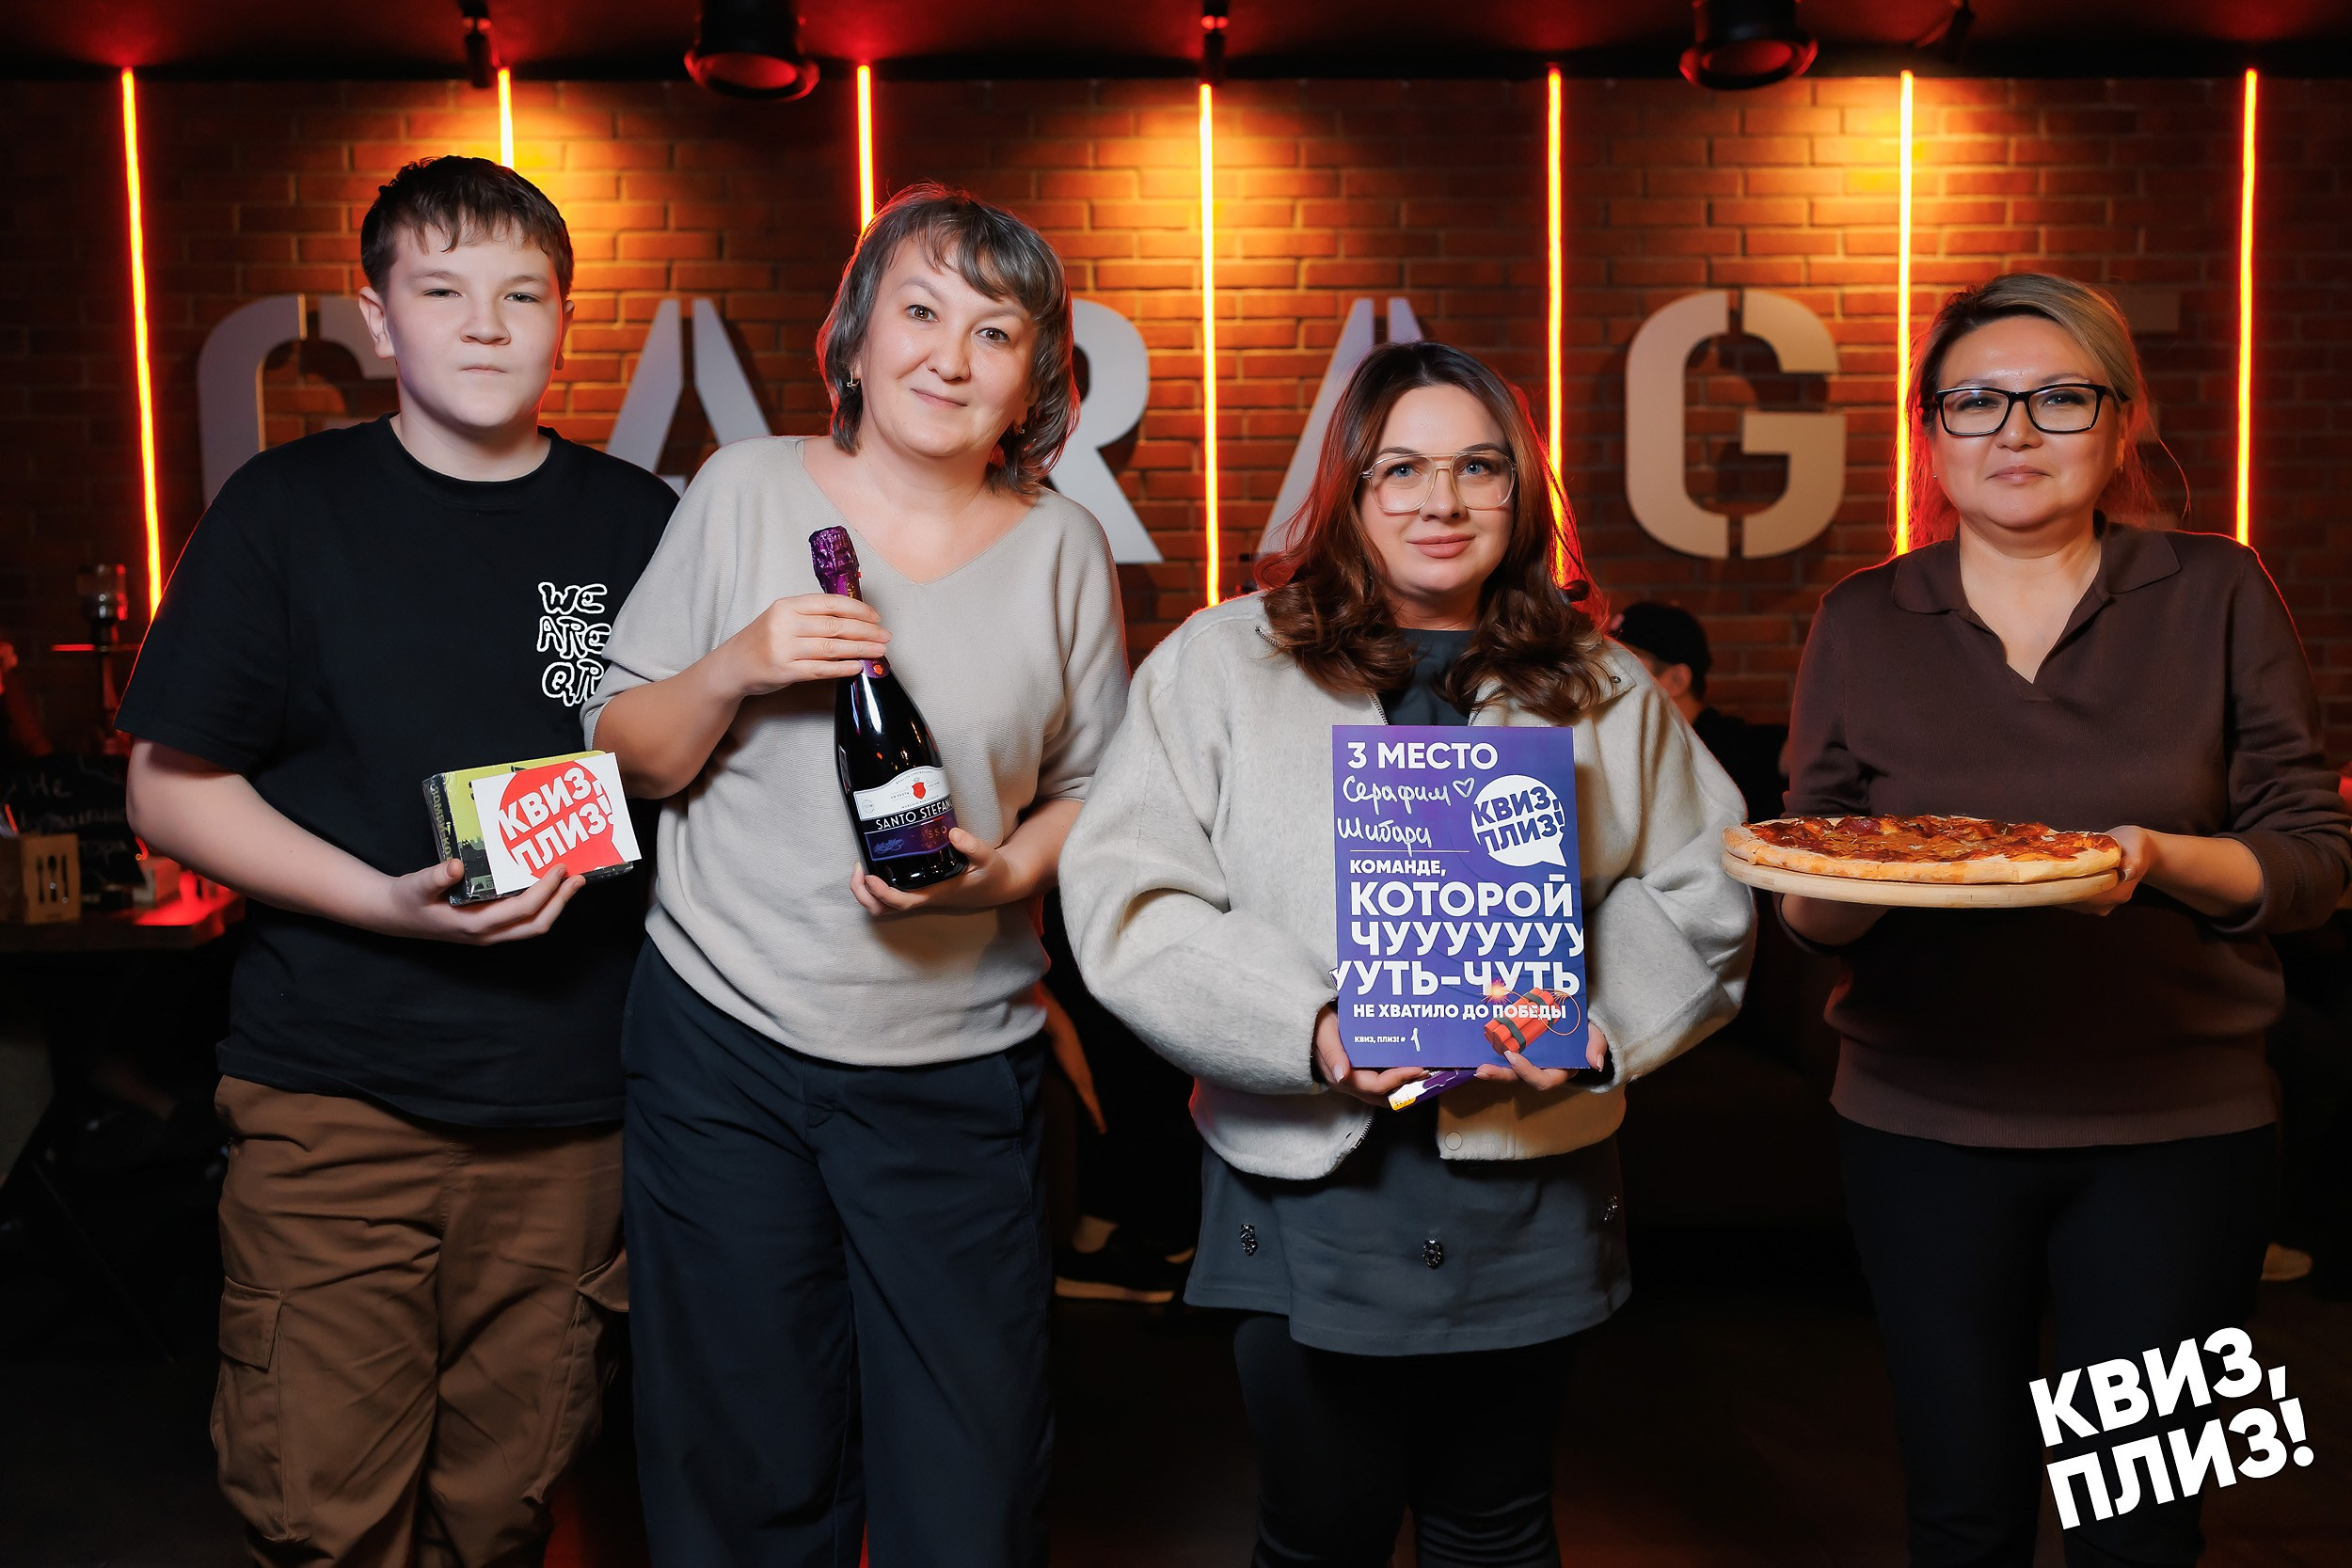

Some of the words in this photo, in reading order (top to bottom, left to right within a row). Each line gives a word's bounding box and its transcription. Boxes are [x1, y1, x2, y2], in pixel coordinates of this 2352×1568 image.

[538, 582, 608, 615] WE
[536, 615, 612, 659] ARE
[1347, 741, 1368, 769] 3
[1377, 741, 1499, 769] МЕСТО
[1343, 774, 1452, 816] Серафим
[511, 794, 614, 875] ПЛИЗ!
[875, 811, 916, 830] SANTO
[1476, 811, 1565, 853] ПЛИЗ!
[1350, 860, 1446, 877] КОМАНДЕ,
[1351, 874, 1573, 917] КОТОРОЙ
[1353, 1004, 1375, 1018] НЕ
[1378, 1004, 1458, 1018] ХВАТИЛО
[1463, 1004, 1488, 1020] ДО
[1492, 1004, 1567, 1020] ПОБЕДЫ
